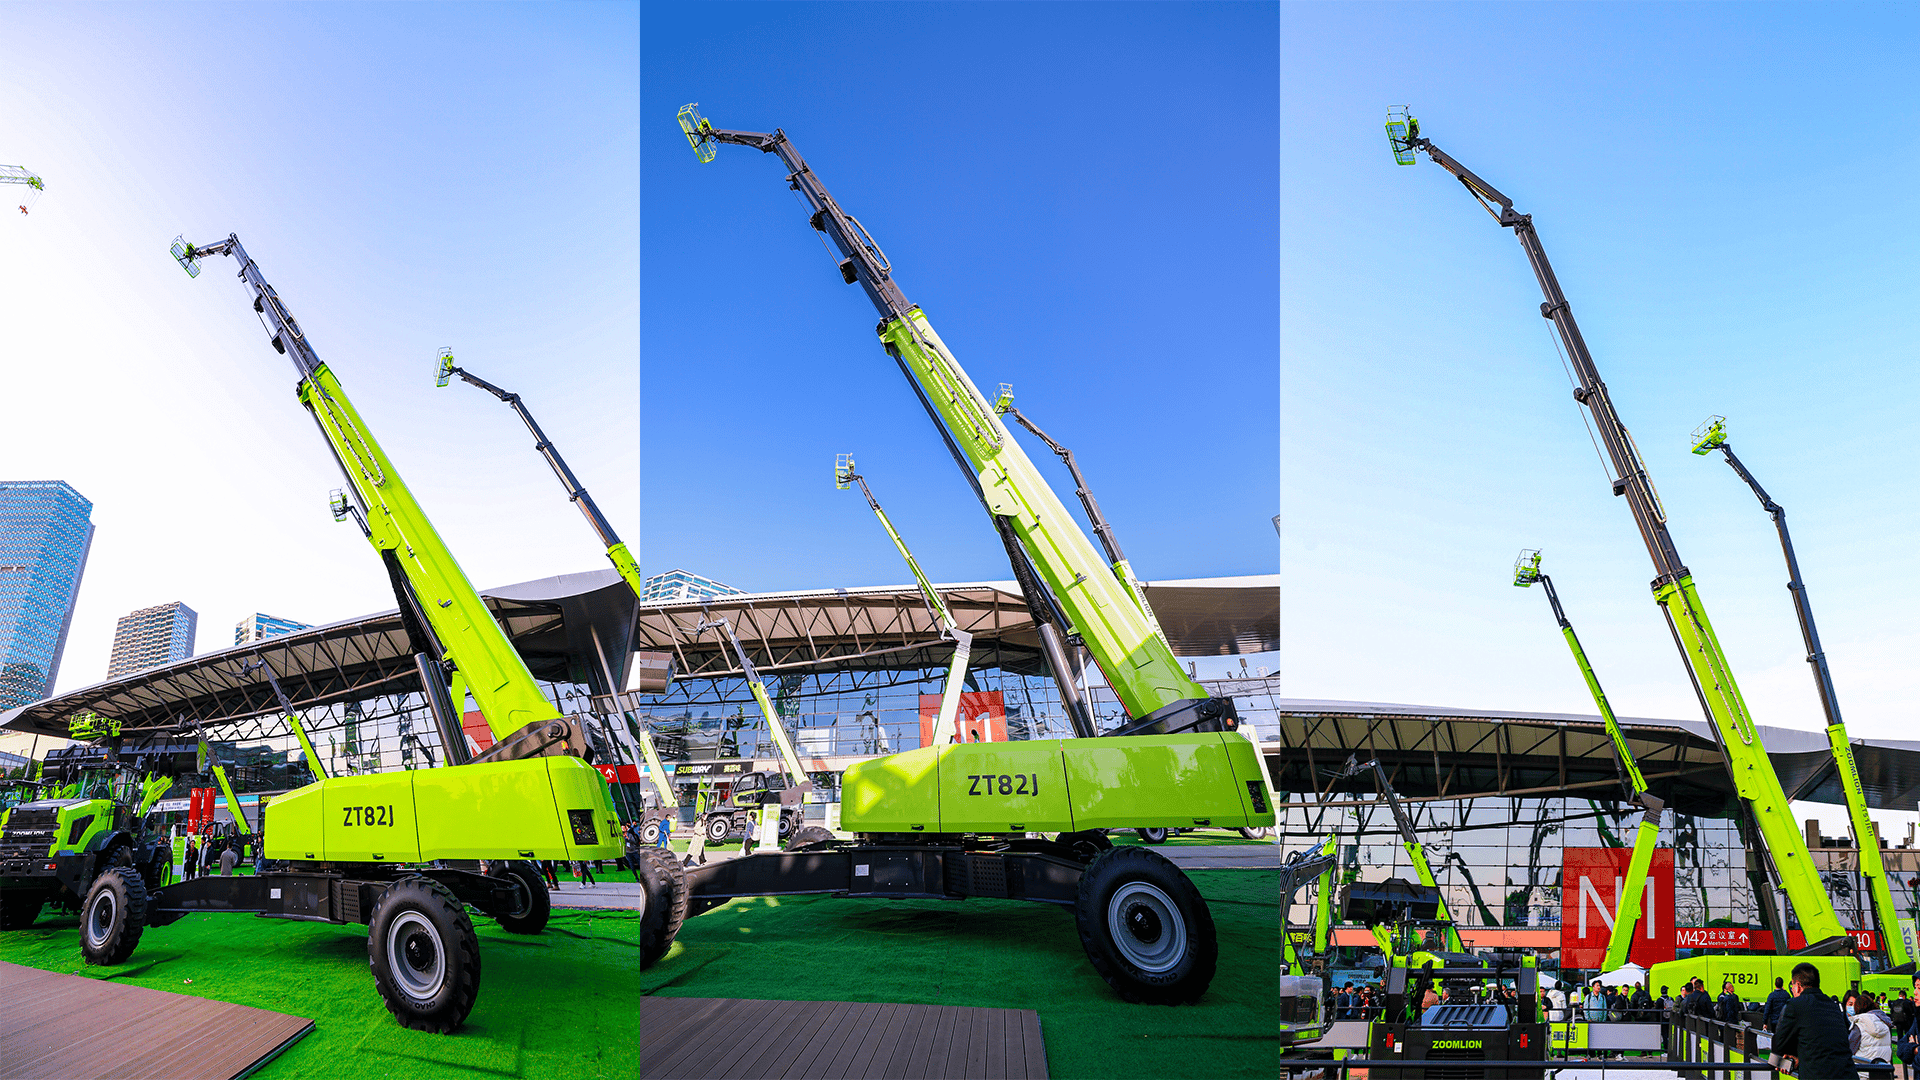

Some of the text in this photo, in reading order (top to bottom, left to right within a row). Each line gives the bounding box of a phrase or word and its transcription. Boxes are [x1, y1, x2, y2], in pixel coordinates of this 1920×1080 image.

[1131, 578, 1153, 617] ZOOMLION
[676, 765, 712, 774] SUBWAY
[1845, 746, 1862, 795] ZOOMLION
[967, 773, 1039, 797] ZT82J
[343, 805, 394, 827] ZT82J
[1676, 930, 1708, 946] M42
[1150, 972, 1178, 983] CHAO
[1723, 973, 1758, 985] ZT82J
[414, 1000, 436, 1010] CHAO
[1432, 1040, 1483, 1049] ZOOMLION
